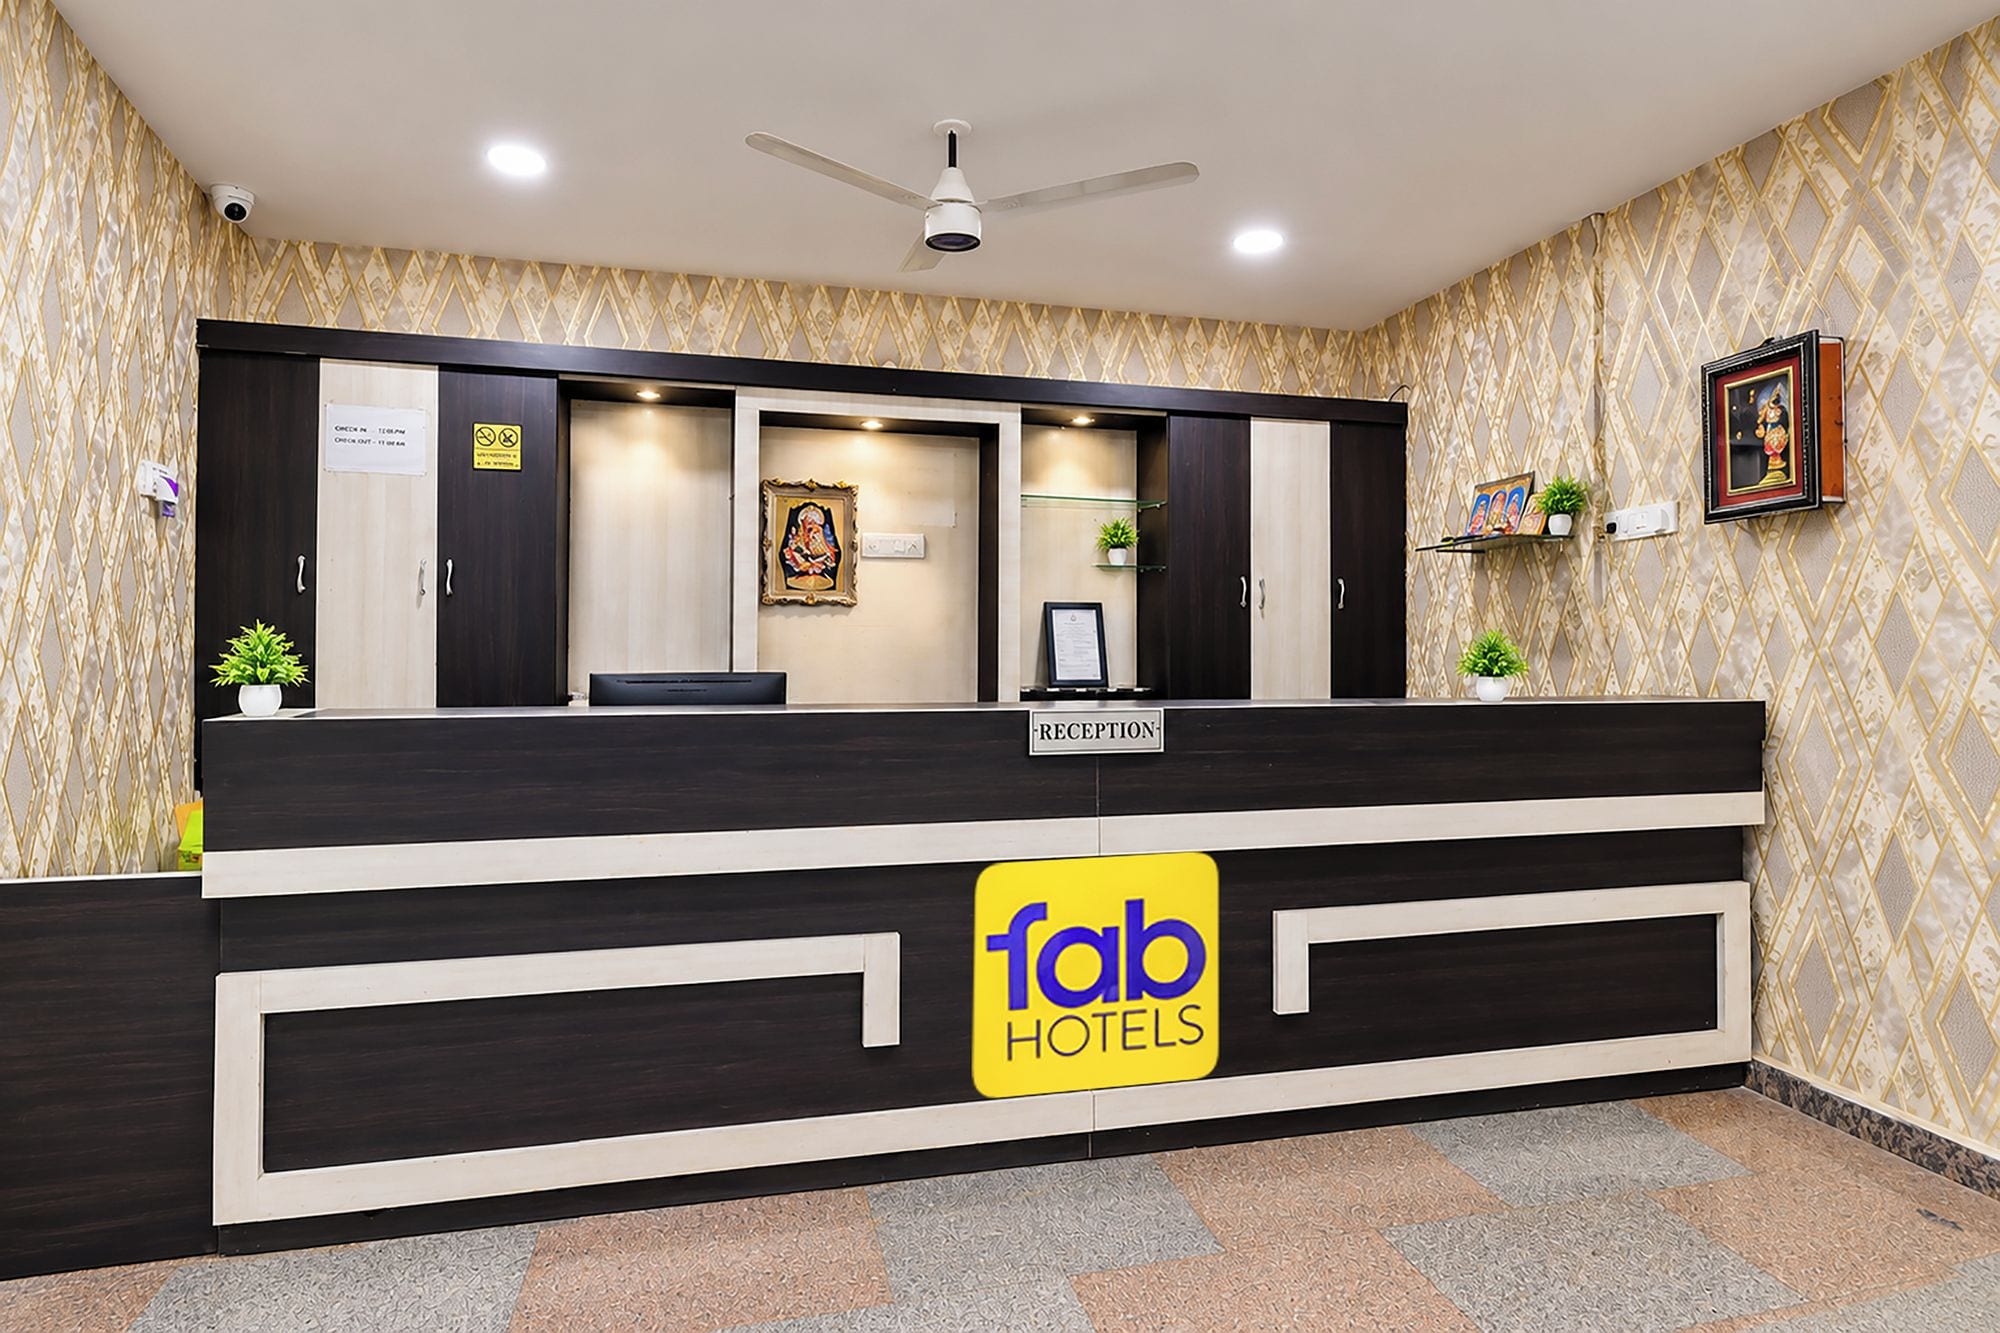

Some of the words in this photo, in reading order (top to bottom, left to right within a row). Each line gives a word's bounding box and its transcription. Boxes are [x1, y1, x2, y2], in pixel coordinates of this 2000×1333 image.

[1039, 721, 1155, 741] RECEPTION
[986, 898, 1207, 1011] fab
[1007, 1004, 1205, 1062] HOTELS
